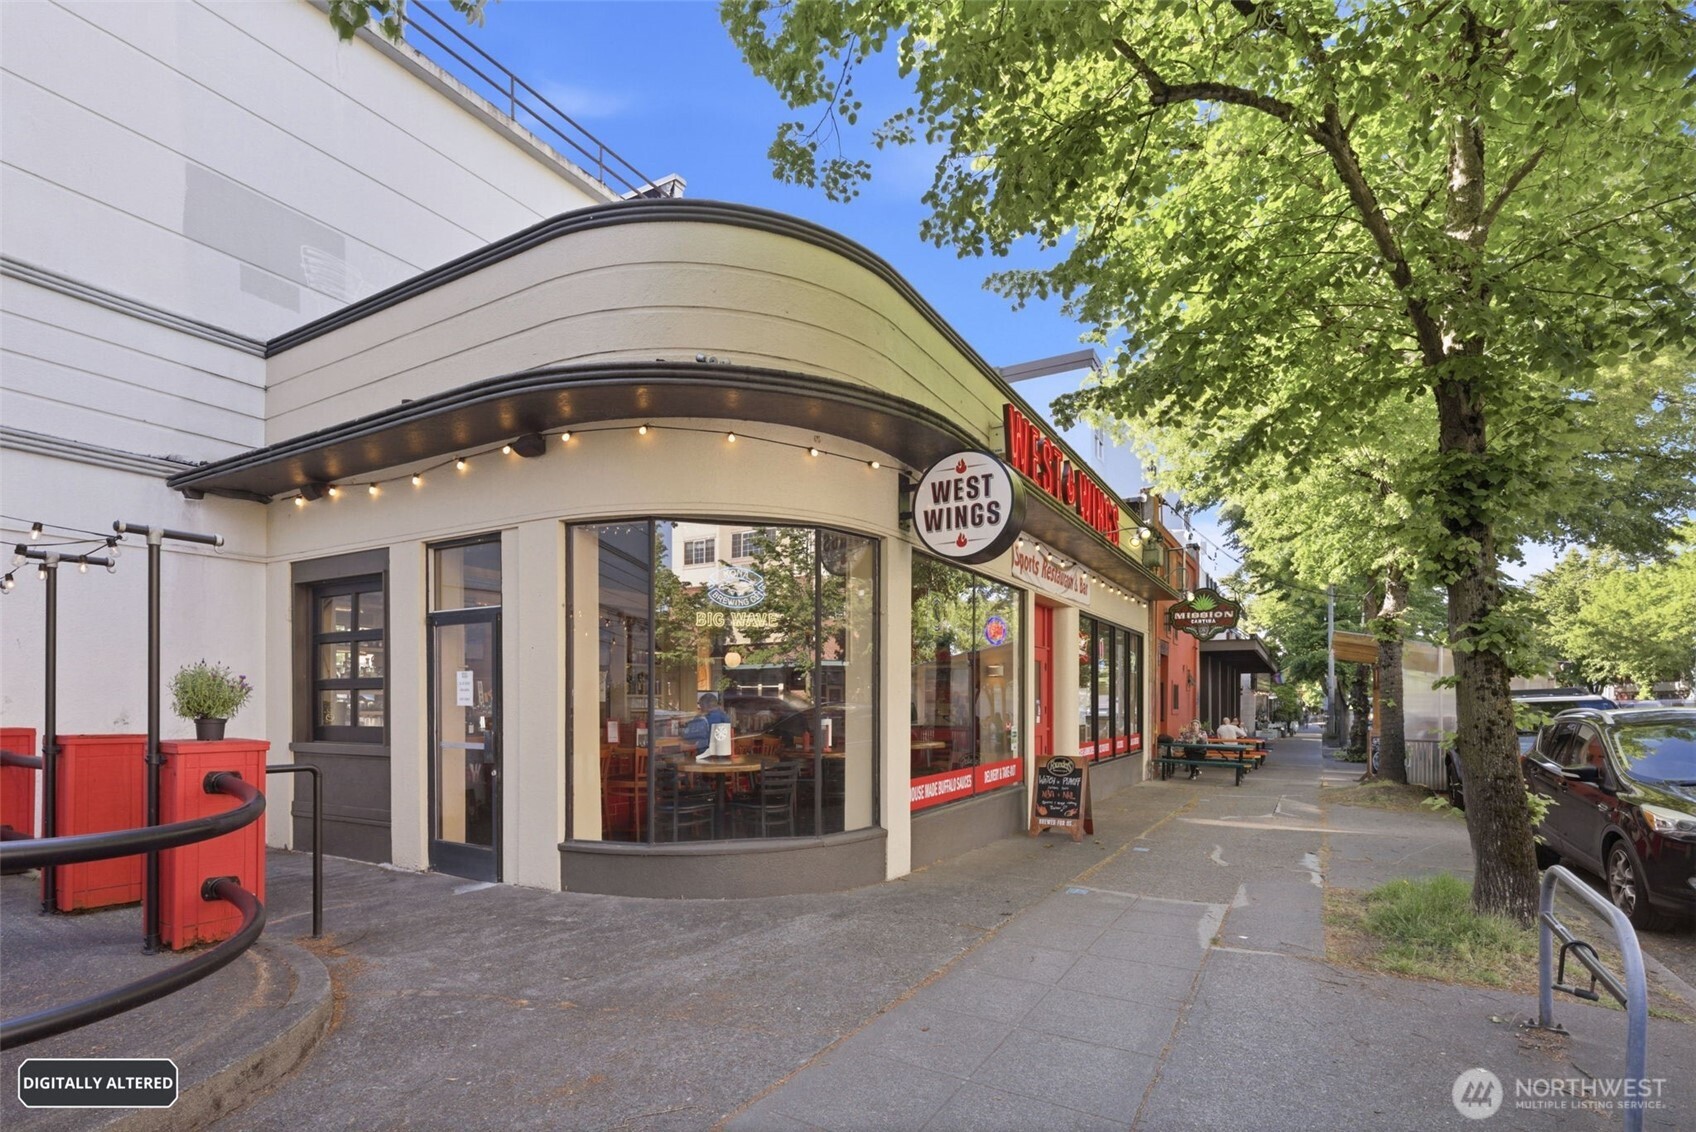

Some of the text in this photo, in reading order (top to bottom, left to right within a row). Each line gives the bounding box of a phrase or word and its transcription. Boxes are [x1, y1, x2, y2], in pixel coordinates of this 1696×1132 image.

[931, 473, 993, 505] WEST
[1003, 403, 1119, 549] WEST WINGS
[923, 500, 1001, 534] WINGS
[1014, 545, 1040, 575] Sports
[1041, 559, 1074, 590] Restaurant
[1079, 577, 1088, 596] Bar
[712, 591, 749, 606] BREWING
[696, 611, 779, 628] BIG WAVE
[1174, 610, 1234, 620] MISSION
[910, 774, 972, 802] OUSE MADE BUFFALO SAUCES
